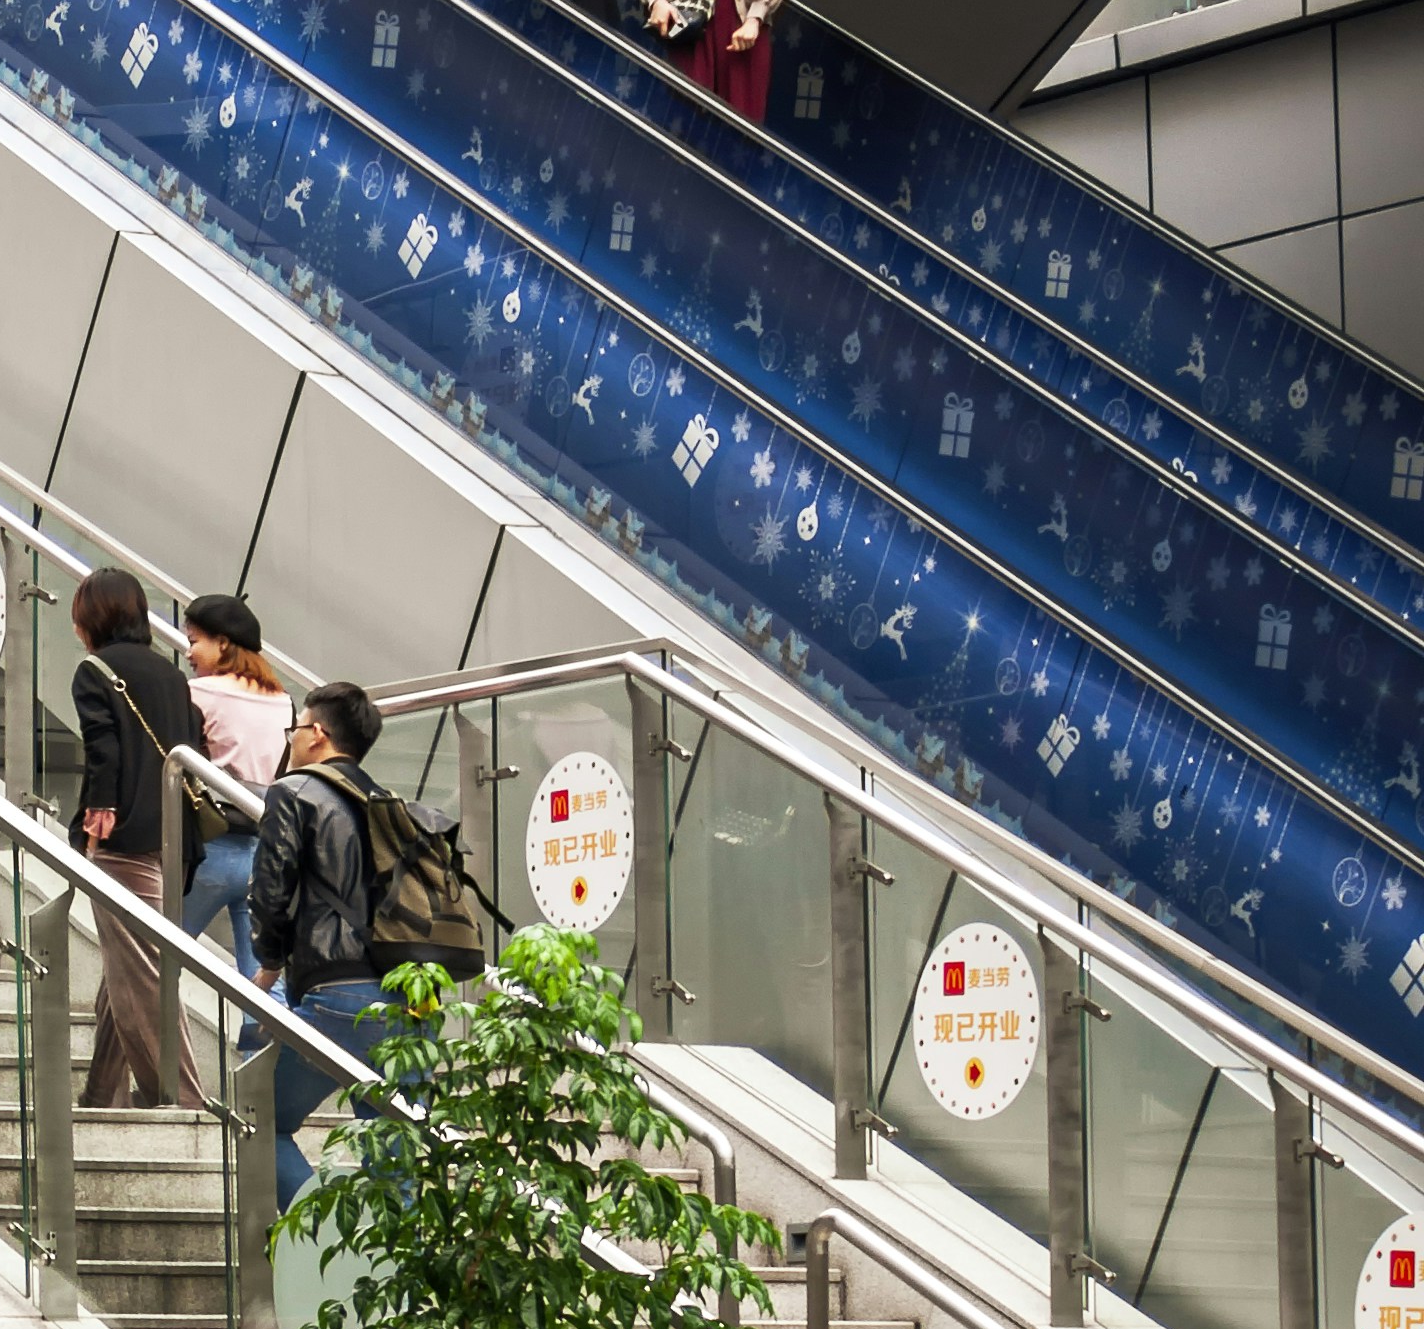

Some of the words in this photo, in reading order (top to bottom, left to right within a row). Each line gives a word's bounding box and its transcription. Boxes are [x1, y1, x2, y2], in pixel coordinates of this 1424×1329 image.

[571, 790, 607, 814] 麦当劳
[544, 829, 616, 866] 现已开业
[967, 966, 1010, 989] 麦当劳
[933, 1010, 1020, 1043] 现已开业
